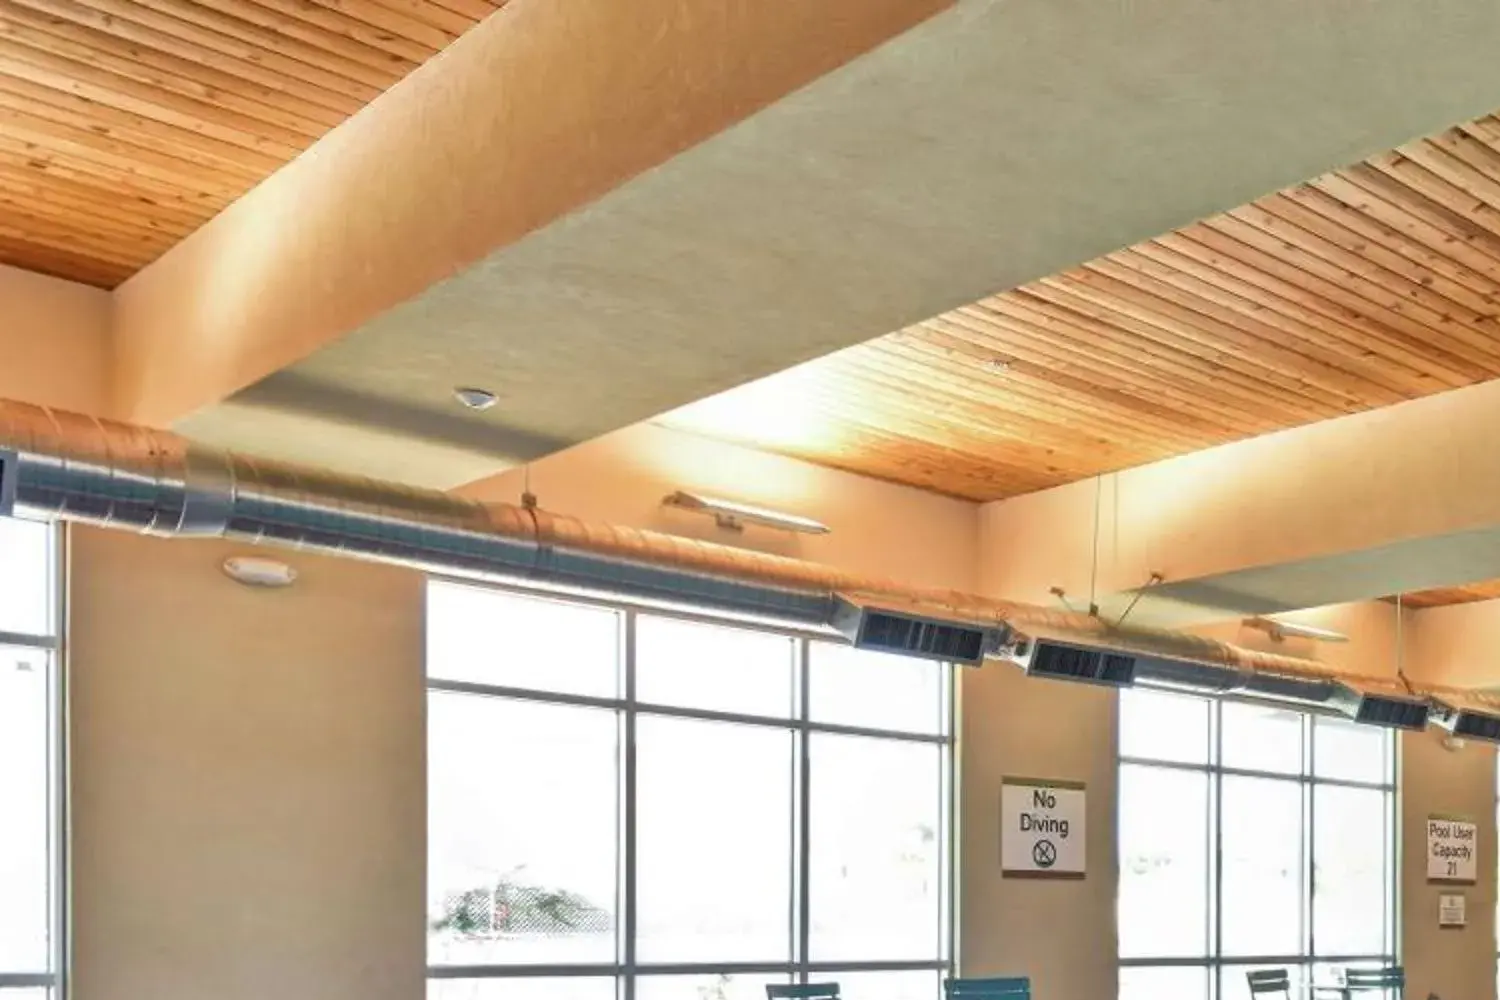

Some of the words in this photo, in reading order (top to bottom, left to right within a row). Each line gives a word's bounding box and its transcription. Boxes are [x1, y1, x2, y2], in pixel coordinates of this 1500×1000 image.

[1033, 789, 1056, 809] No
[1020, 813, 1069, 838] Diving
[1430, 823, 1450, 838] Pool
[1453, 825, 1473, 840] User
[1432, 841, 1472, 861] Capacity
